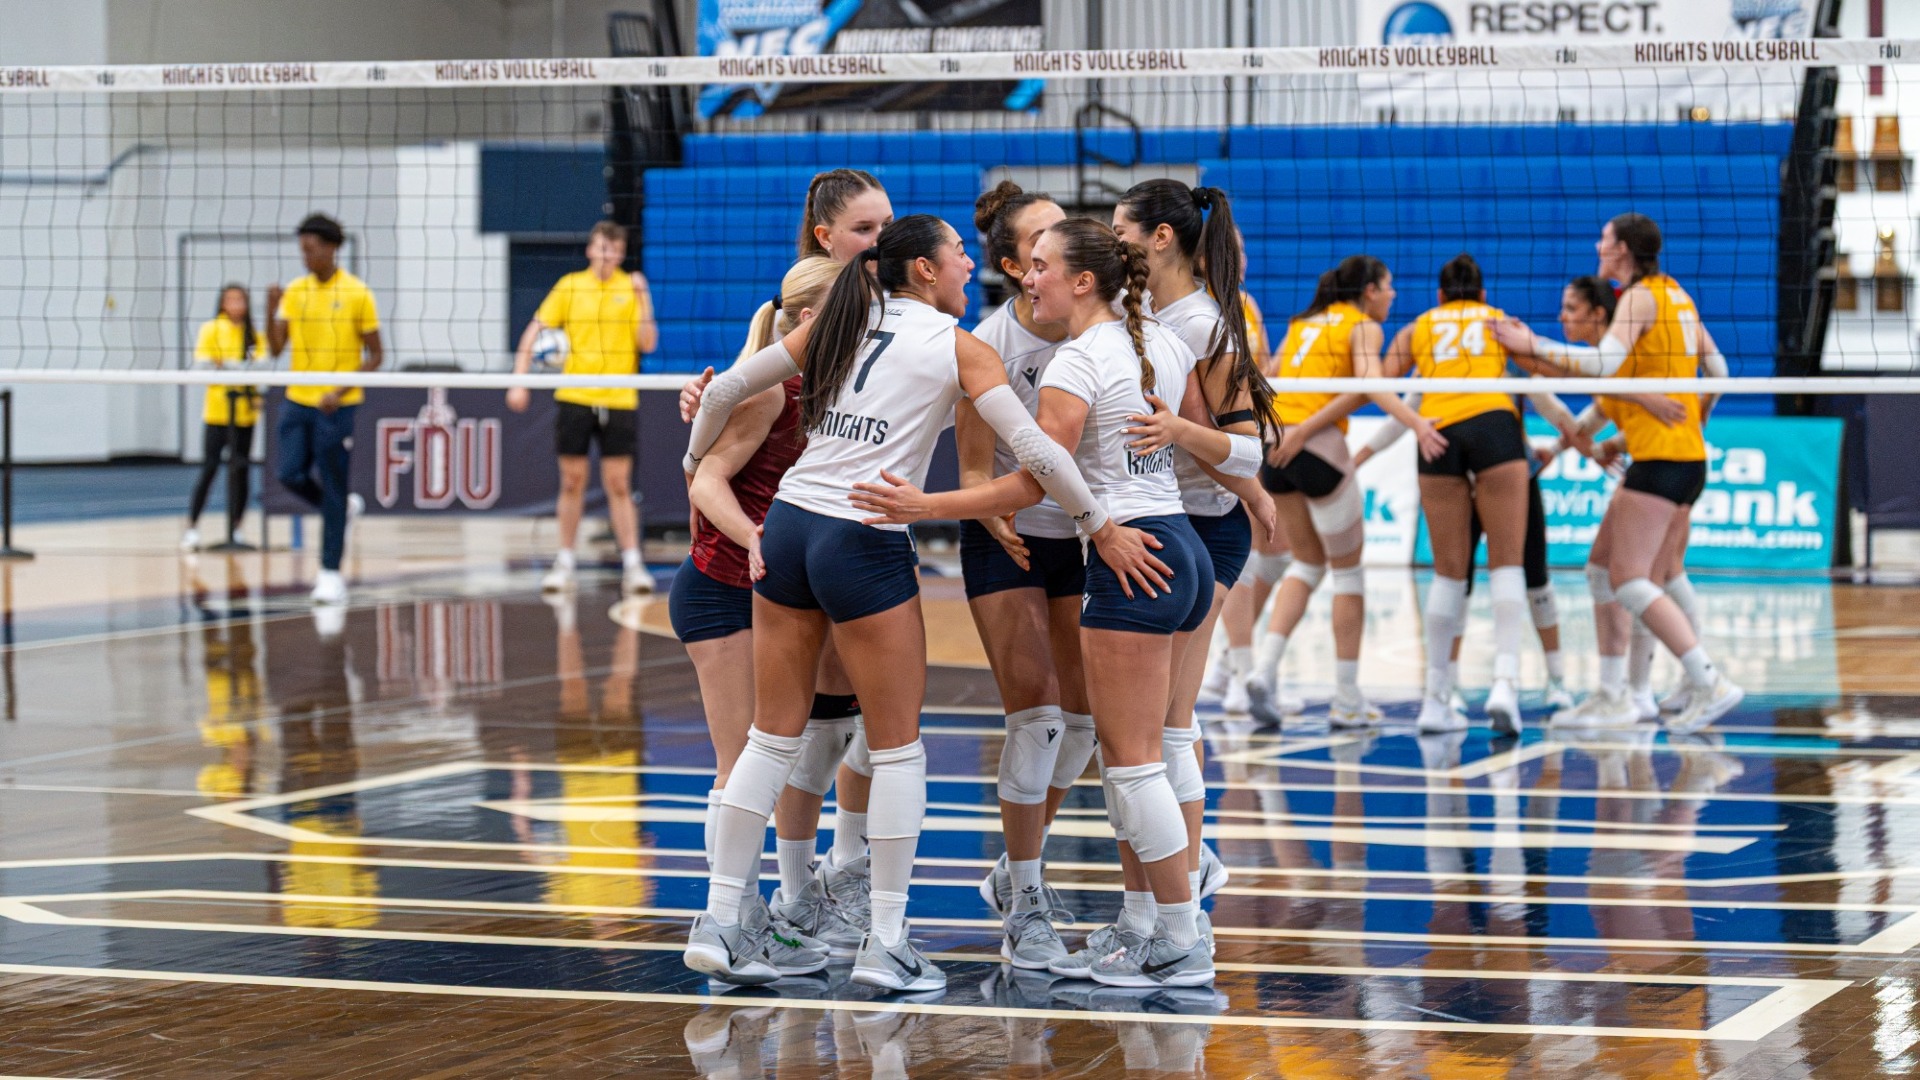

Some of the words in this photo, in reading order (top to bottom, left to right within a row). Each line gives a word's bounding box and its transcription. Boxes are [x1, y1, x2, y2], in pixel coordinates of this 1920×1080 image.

[1470, 3, 1665, 34] RESPECT.
[1013, 53, 1082, 73] KNIGHTS
[1087, 51, 1188, 71] VOLLEYBALL
[1319, 48, 1390, 68] KNIGHTS
[1394, 46, 1499, 66] VOLLEYBALL
[1635, 42, 1708, 63] KNIGHTS
[1712, 40, 1820, 62] VOLLEYBALL
[162, 66, 224, 85] KNIGHTS
[228, 63, 318, 84] VOLLEYBALL
[435, 61, 498, 82] KNIGHTS
[502, 59, 597, 80] VOLLEYBALL
[719, 57, 784, 77] KNIGHTS
[789, 55, 886, 76] VOLLEYBALL
[1290, 326, 1322, 367] 7
[1432, 320, 1486, 365] 24
[853, 328, 896, 394] 7
[815, 410, 889, 445] NIGHTS
[376, 417, 502, 510] FDU
